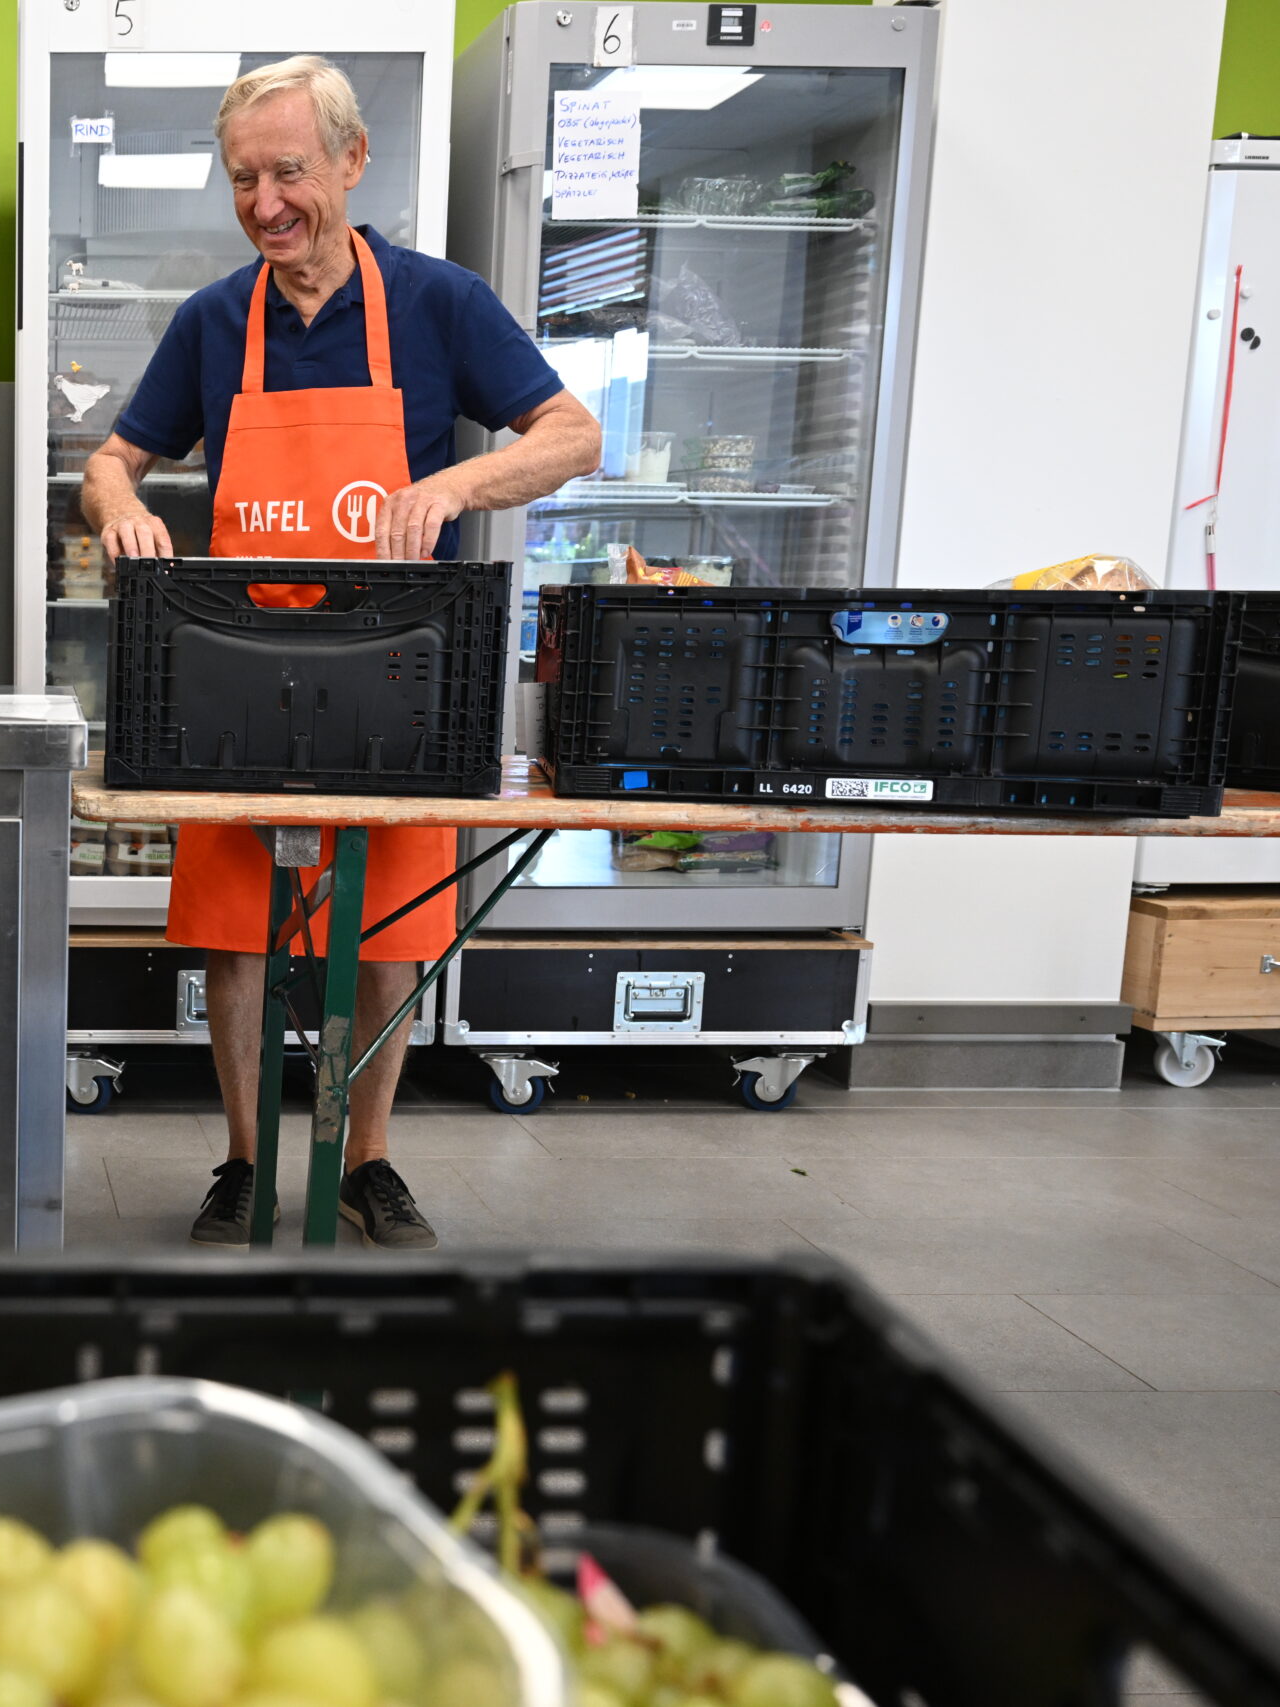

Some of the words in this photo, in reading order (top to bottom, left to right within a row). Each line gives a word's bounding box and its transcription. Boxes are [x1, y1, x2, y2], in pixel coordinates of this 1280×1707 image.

[114, 0, 137, 36] 5
[603, 13, 621, 55] 6
[74, 122, 112, 137] RIND
[235, 500, 310, 532] TAFEL
[759, 783, 774, 794] LL
[782, 783, 813, 795] 6420
[873, 782, 912, 793] IFCO
